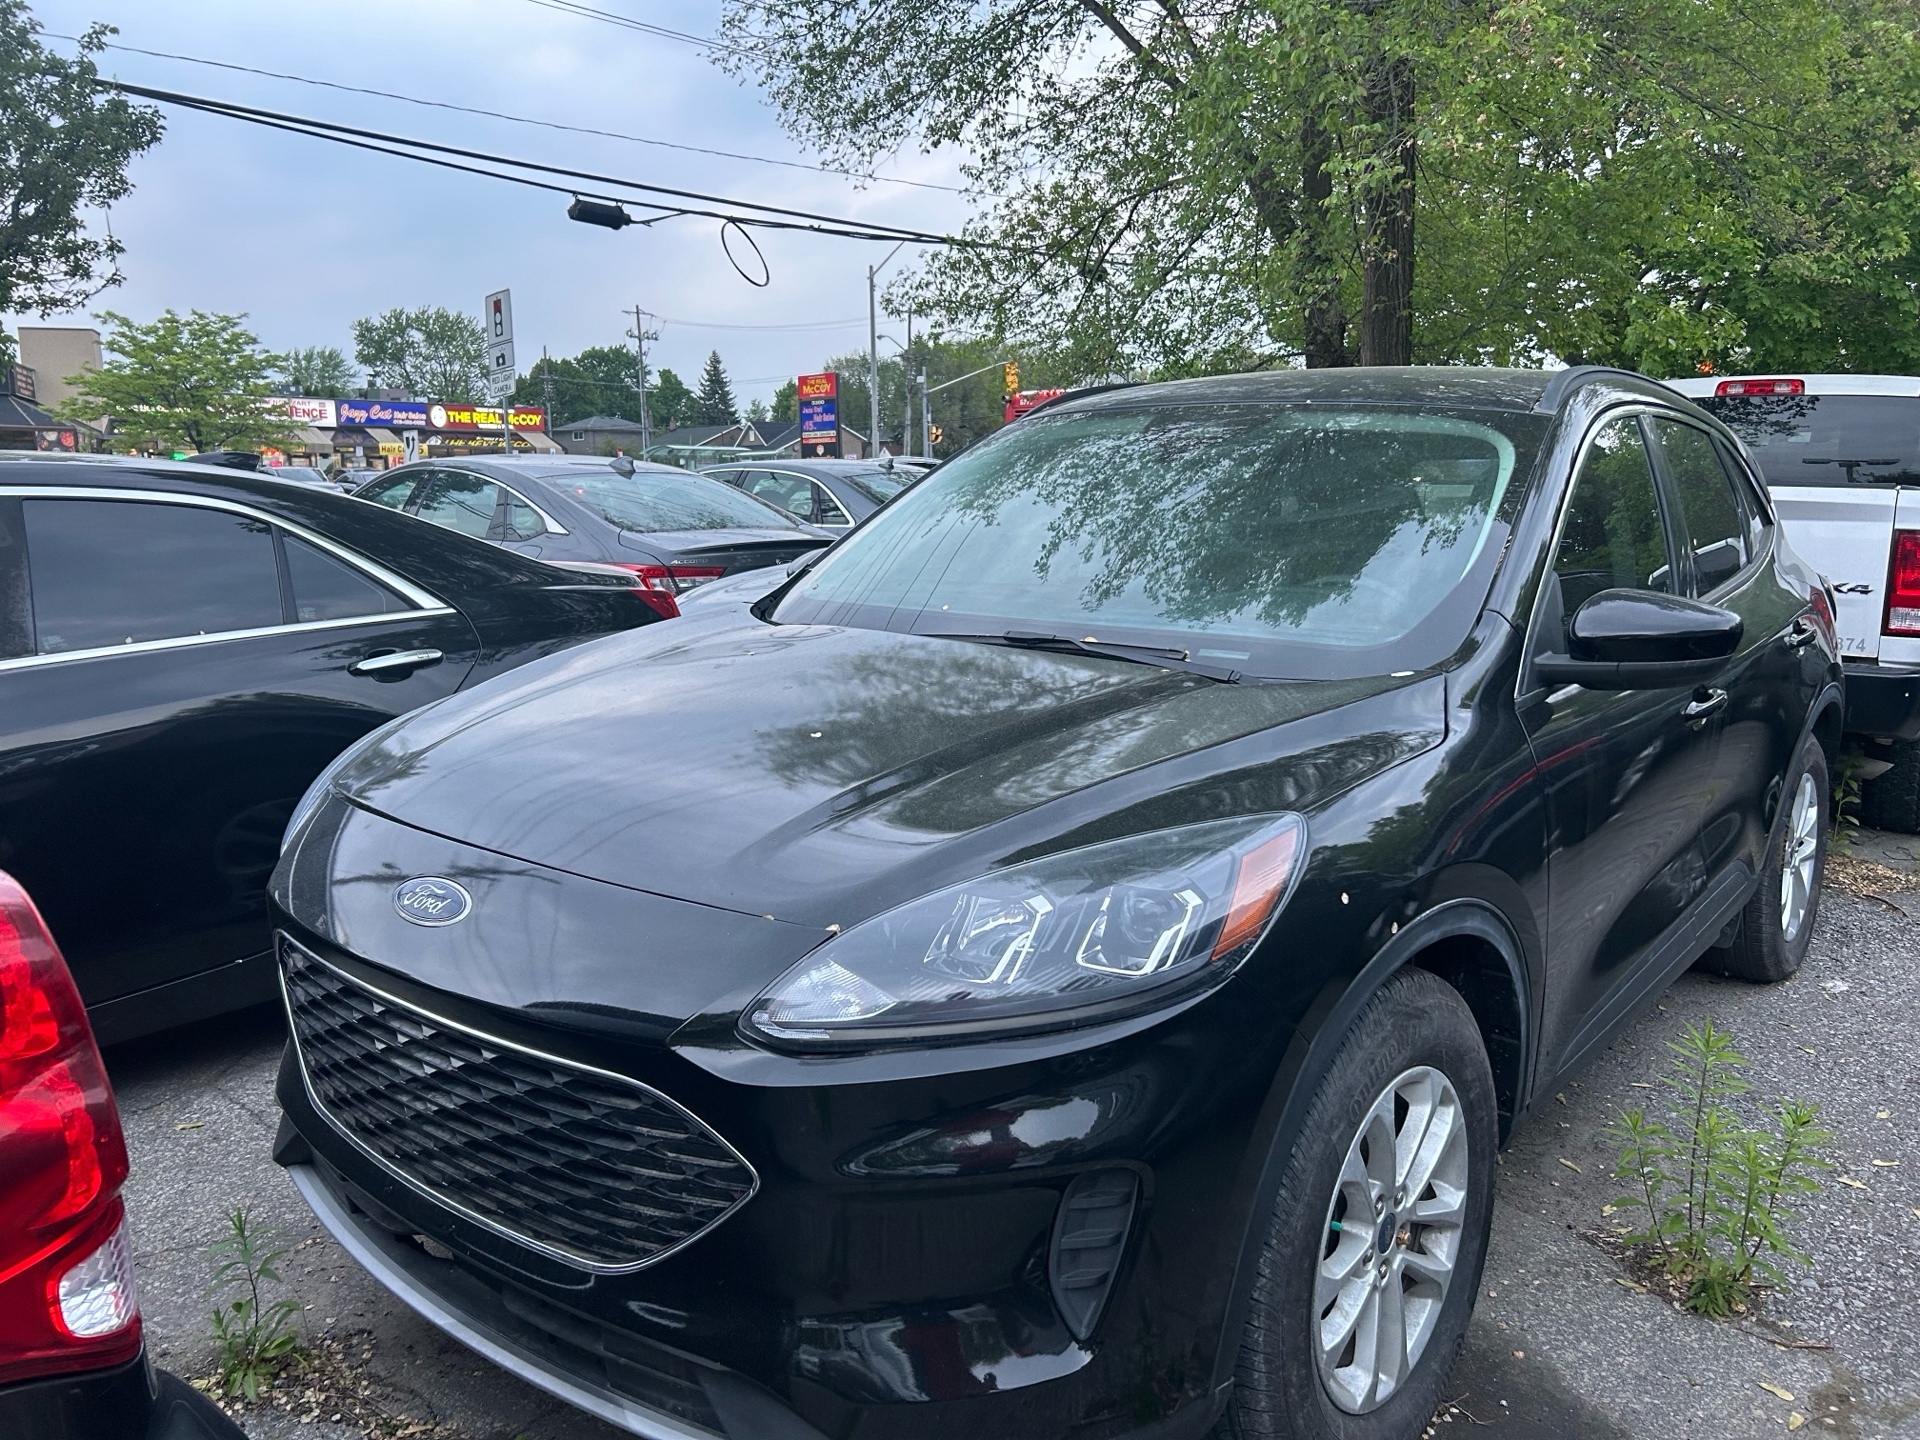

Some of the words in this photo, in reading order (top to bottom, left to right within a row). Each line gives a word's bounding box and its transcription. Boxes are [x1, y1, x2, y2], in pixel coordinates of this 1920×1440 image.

[492, 376, 500, 384] RED
[501, 372, 512, 382] LIGHT
[494, 384, 511, 393] CAMERA
[803, 383, 831, 394] McCOY
[369, 404, 392, 419] Cut
[447, 411, 471, 423] THE
[472, 413, 502, 424] REAL
[381, 445, 396, 453] Hair
[403, 884, 452, 915] Ford
